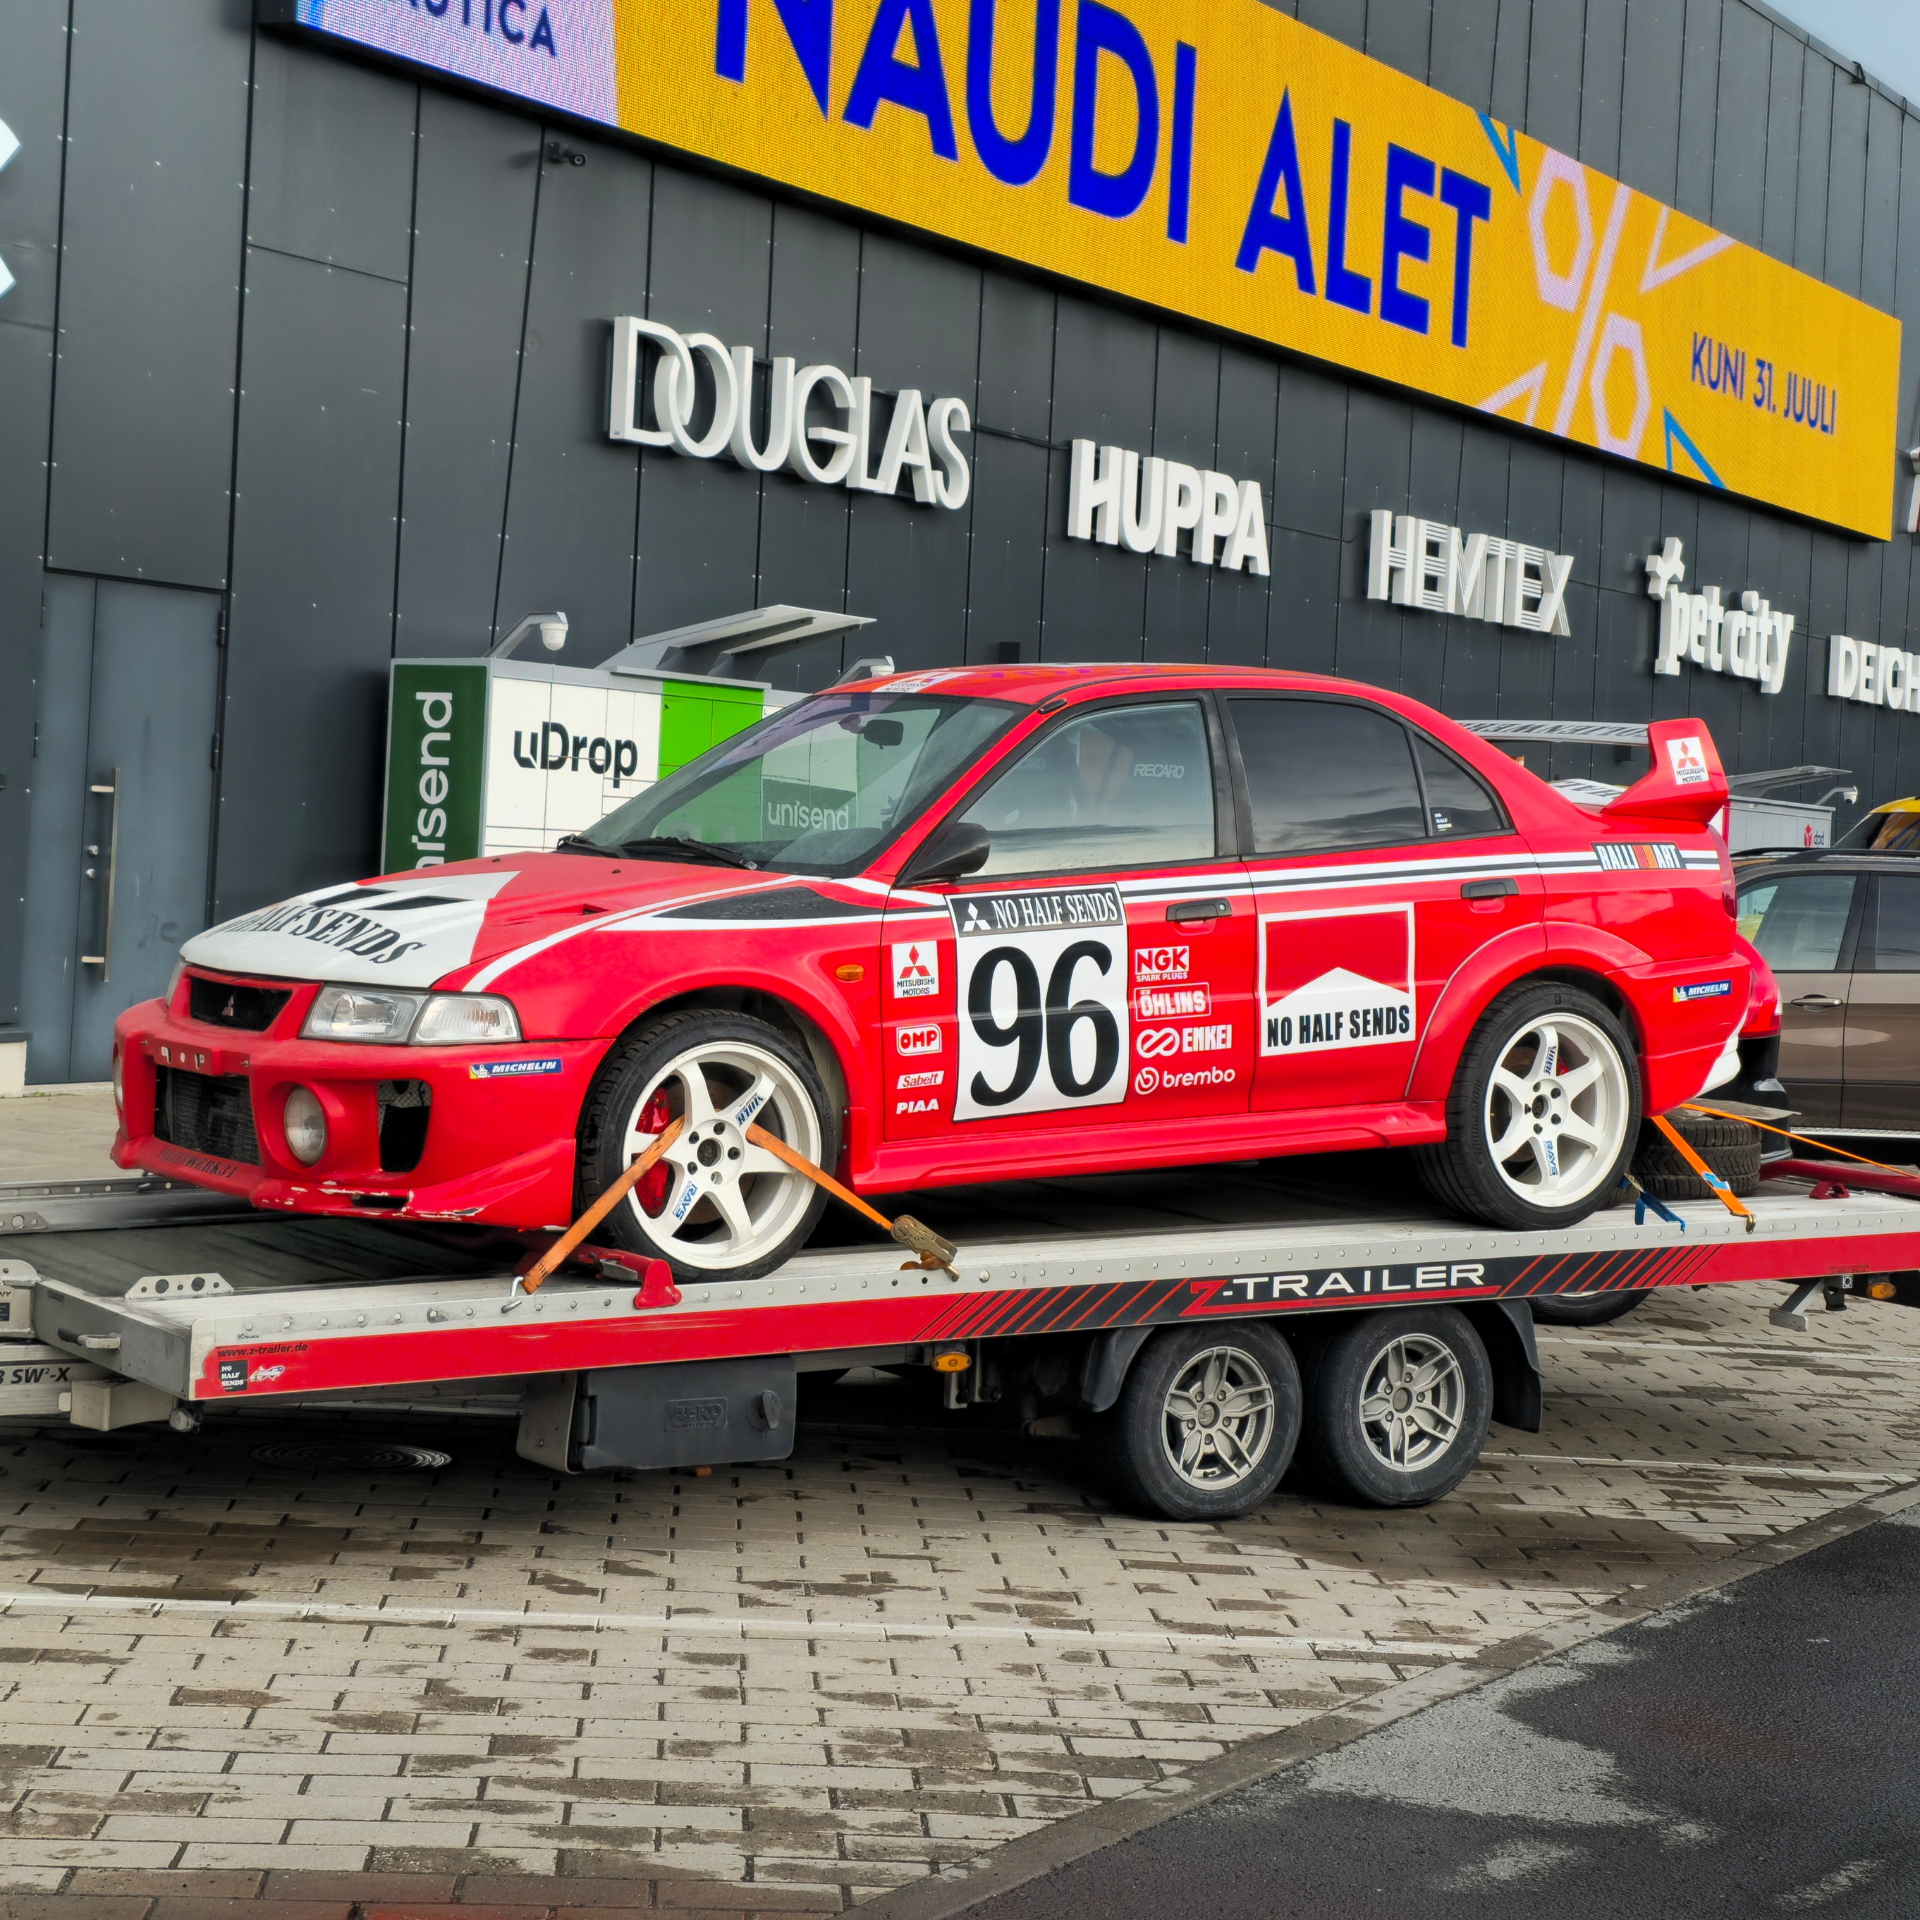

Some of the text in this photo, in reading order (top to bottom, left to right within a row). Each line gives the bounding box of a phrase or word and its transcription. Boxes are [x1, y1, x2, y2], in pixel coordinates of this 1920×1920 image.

[1234, 85, 1492, 349] ALET
[1691, 331, 1836, 436] KUNI 31. JUULI
[609, 315, 971, 510] DOUGLAS
[1068, 439, 1270, 576] HUPPA
[1367, 509, 1575, 637] HEMTEX
[1654, 580, 1796, 694] petcity
[1828, 634, 1920, 714] DEICH
[513, 720, 638, 789] uDrop
[1132, 763, 1185, 779] RECARO
[767, 801, 849, 830] unisend
[1813, 830, 1825, 848] dpd
[991, 892, 1119, 930] NO HALF SENDS
[288, 906, 427, 965] SENDS
[1136, 946, 1188, 973] NGK
[896, 977, 936, 988] MITSUBISHI
[1135, 972, 1188, 982] SPARK PLUGS
[1687, 982, 1730, 996] MICHELIN
[902, 987, 930, 997] MOTORS
[1139, 989, 1207, 1017] ÖHLINS
[968, 940, 1121, 1106] 96
[1267, 1004, 1410, 1048] NO HALF SENDS
[900, 1029, 938, 1050] OMP
[1182, 1024, 1233, 1053] ENKEI
[491, 1060, 557, 1073] MICHELIN
[902, 1072, 939, 1088] Sabelt
[1162, 1066, 1236, 1089] brembo
[896, 1098, 940, 1115] PIAA
[1545, 1140, 1558, 1176] RAYS
[675, 1183, 698, 1221] RAYS
[1181, 1263, 1486, 1316] Z-TRAILER
[217, 1343, 308, 1357] www.z-trailer.de
[221, 1379, 244, 1387] SENDS
